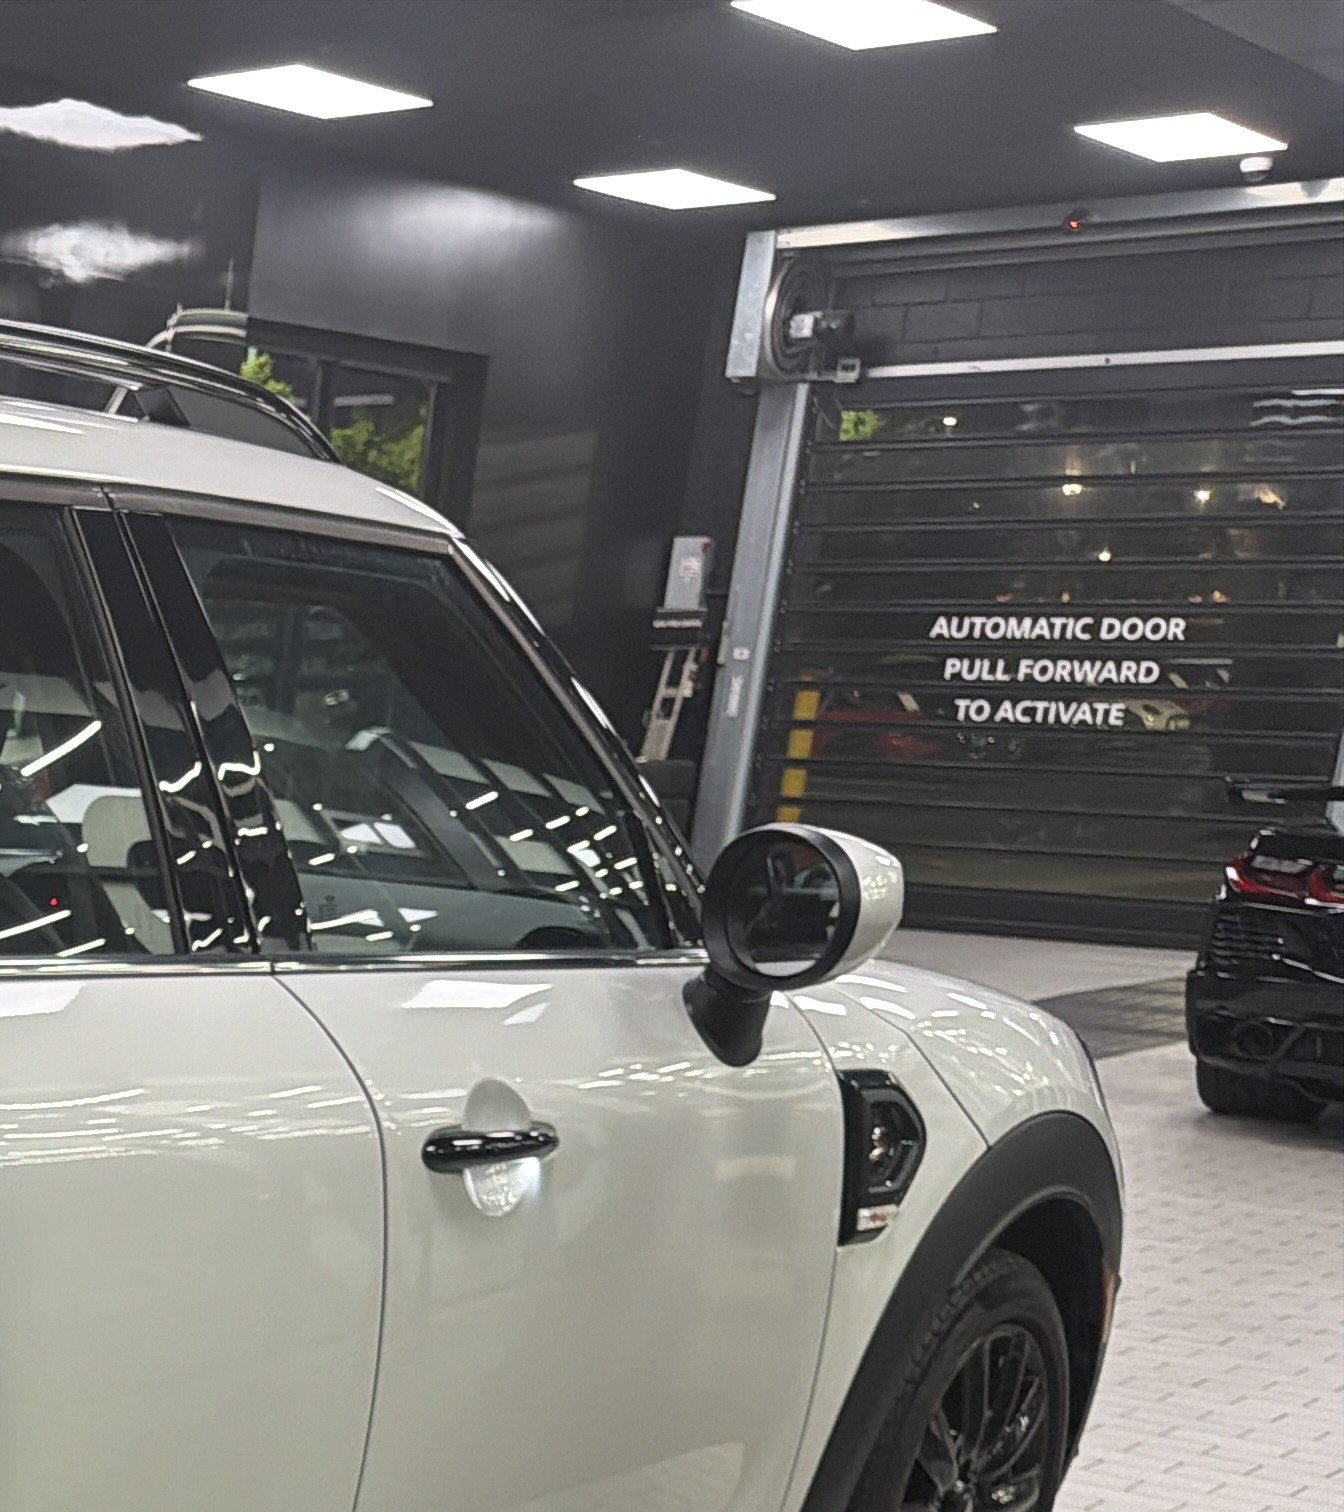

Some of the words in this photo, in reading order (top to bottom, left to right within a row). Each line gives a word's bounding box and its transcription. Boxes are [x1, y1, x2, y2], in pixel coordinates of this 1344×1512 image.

[929, 616, 1094, 640] AUTOMATIC
[1100, 617, 1186, 641] DOOR
[943, 657, 1011, 681] PULL
[1017, 658, 1160, 684] FORWARD
[954, 698, 991, 722] TO
[994, 700, 1126, 726] ACTIVATE
